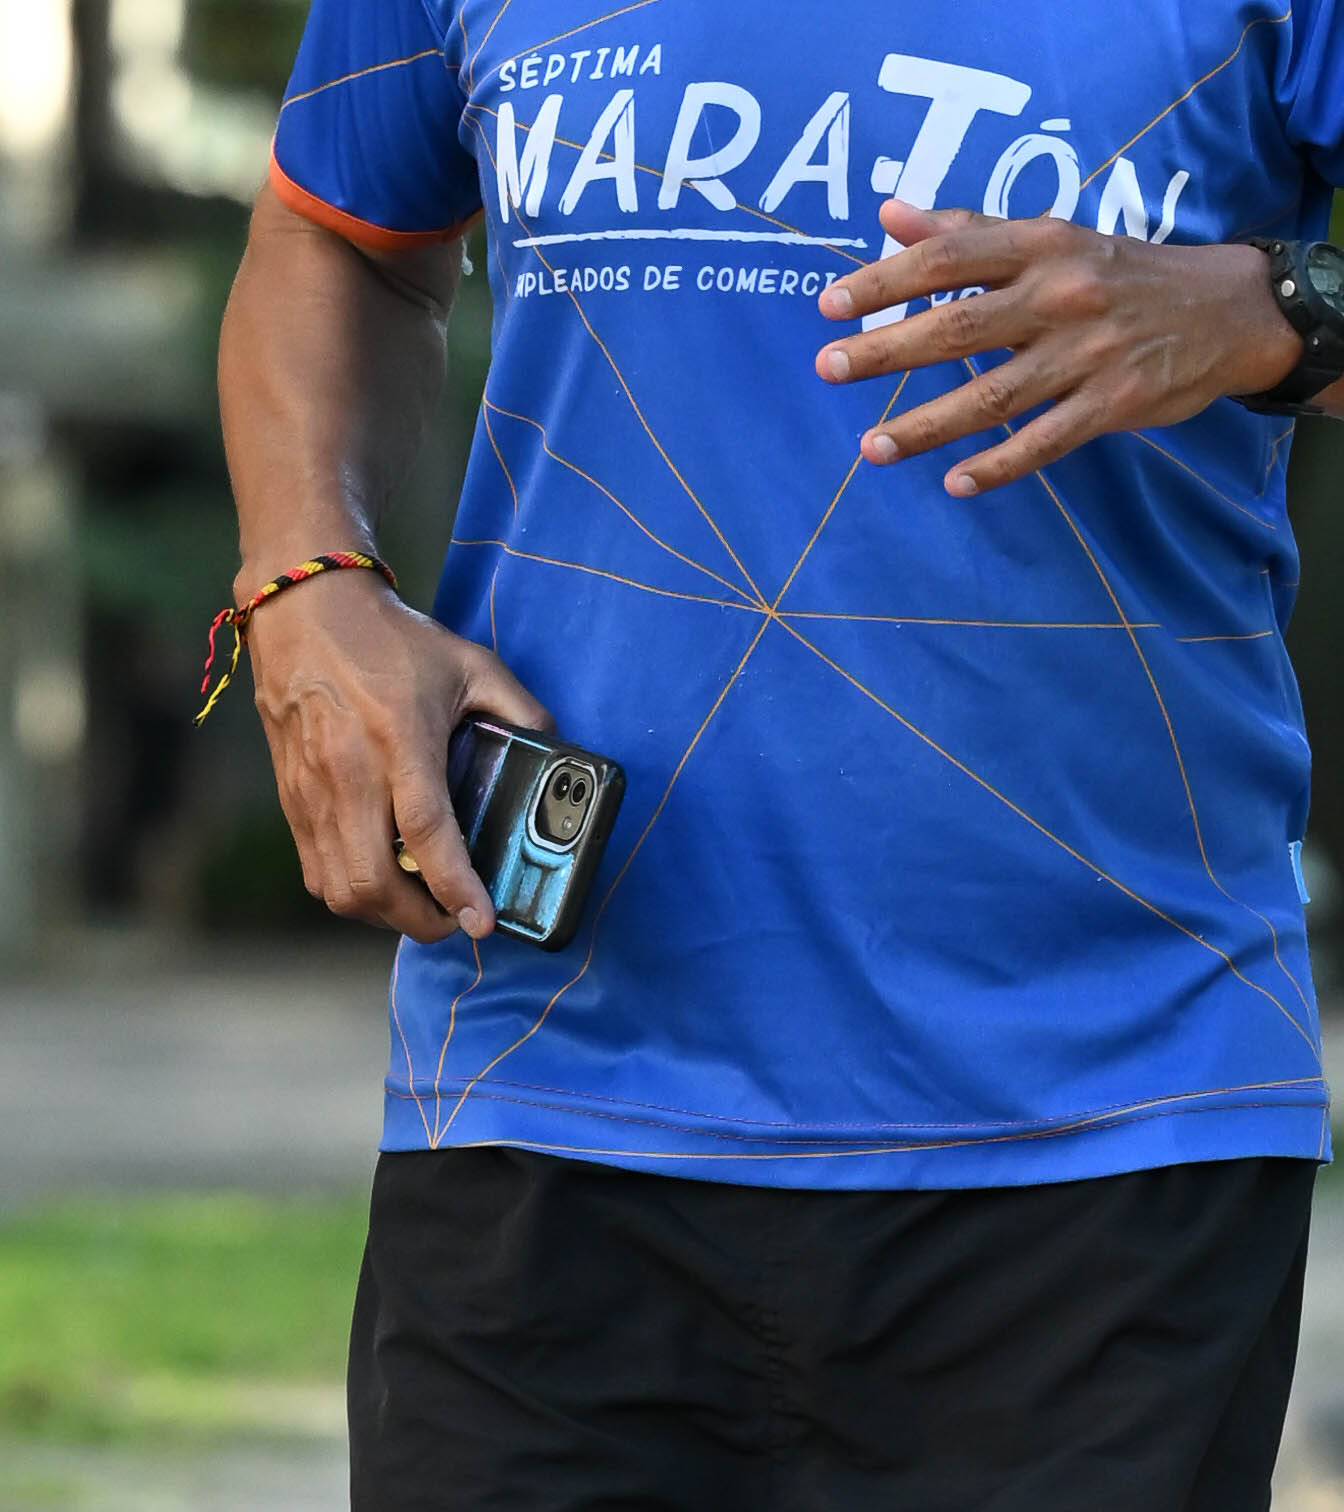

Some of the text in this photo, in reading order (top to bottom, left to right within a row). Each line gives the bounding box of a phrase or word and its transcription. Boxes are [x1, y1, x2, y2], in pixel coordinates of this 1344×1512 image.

[498, 43, 662, 92] SÉPTIMA
[495, 52, 1191, 333] MARATÓN
[514, 265, 838, 299] MPLEADOS DE COMERCI
